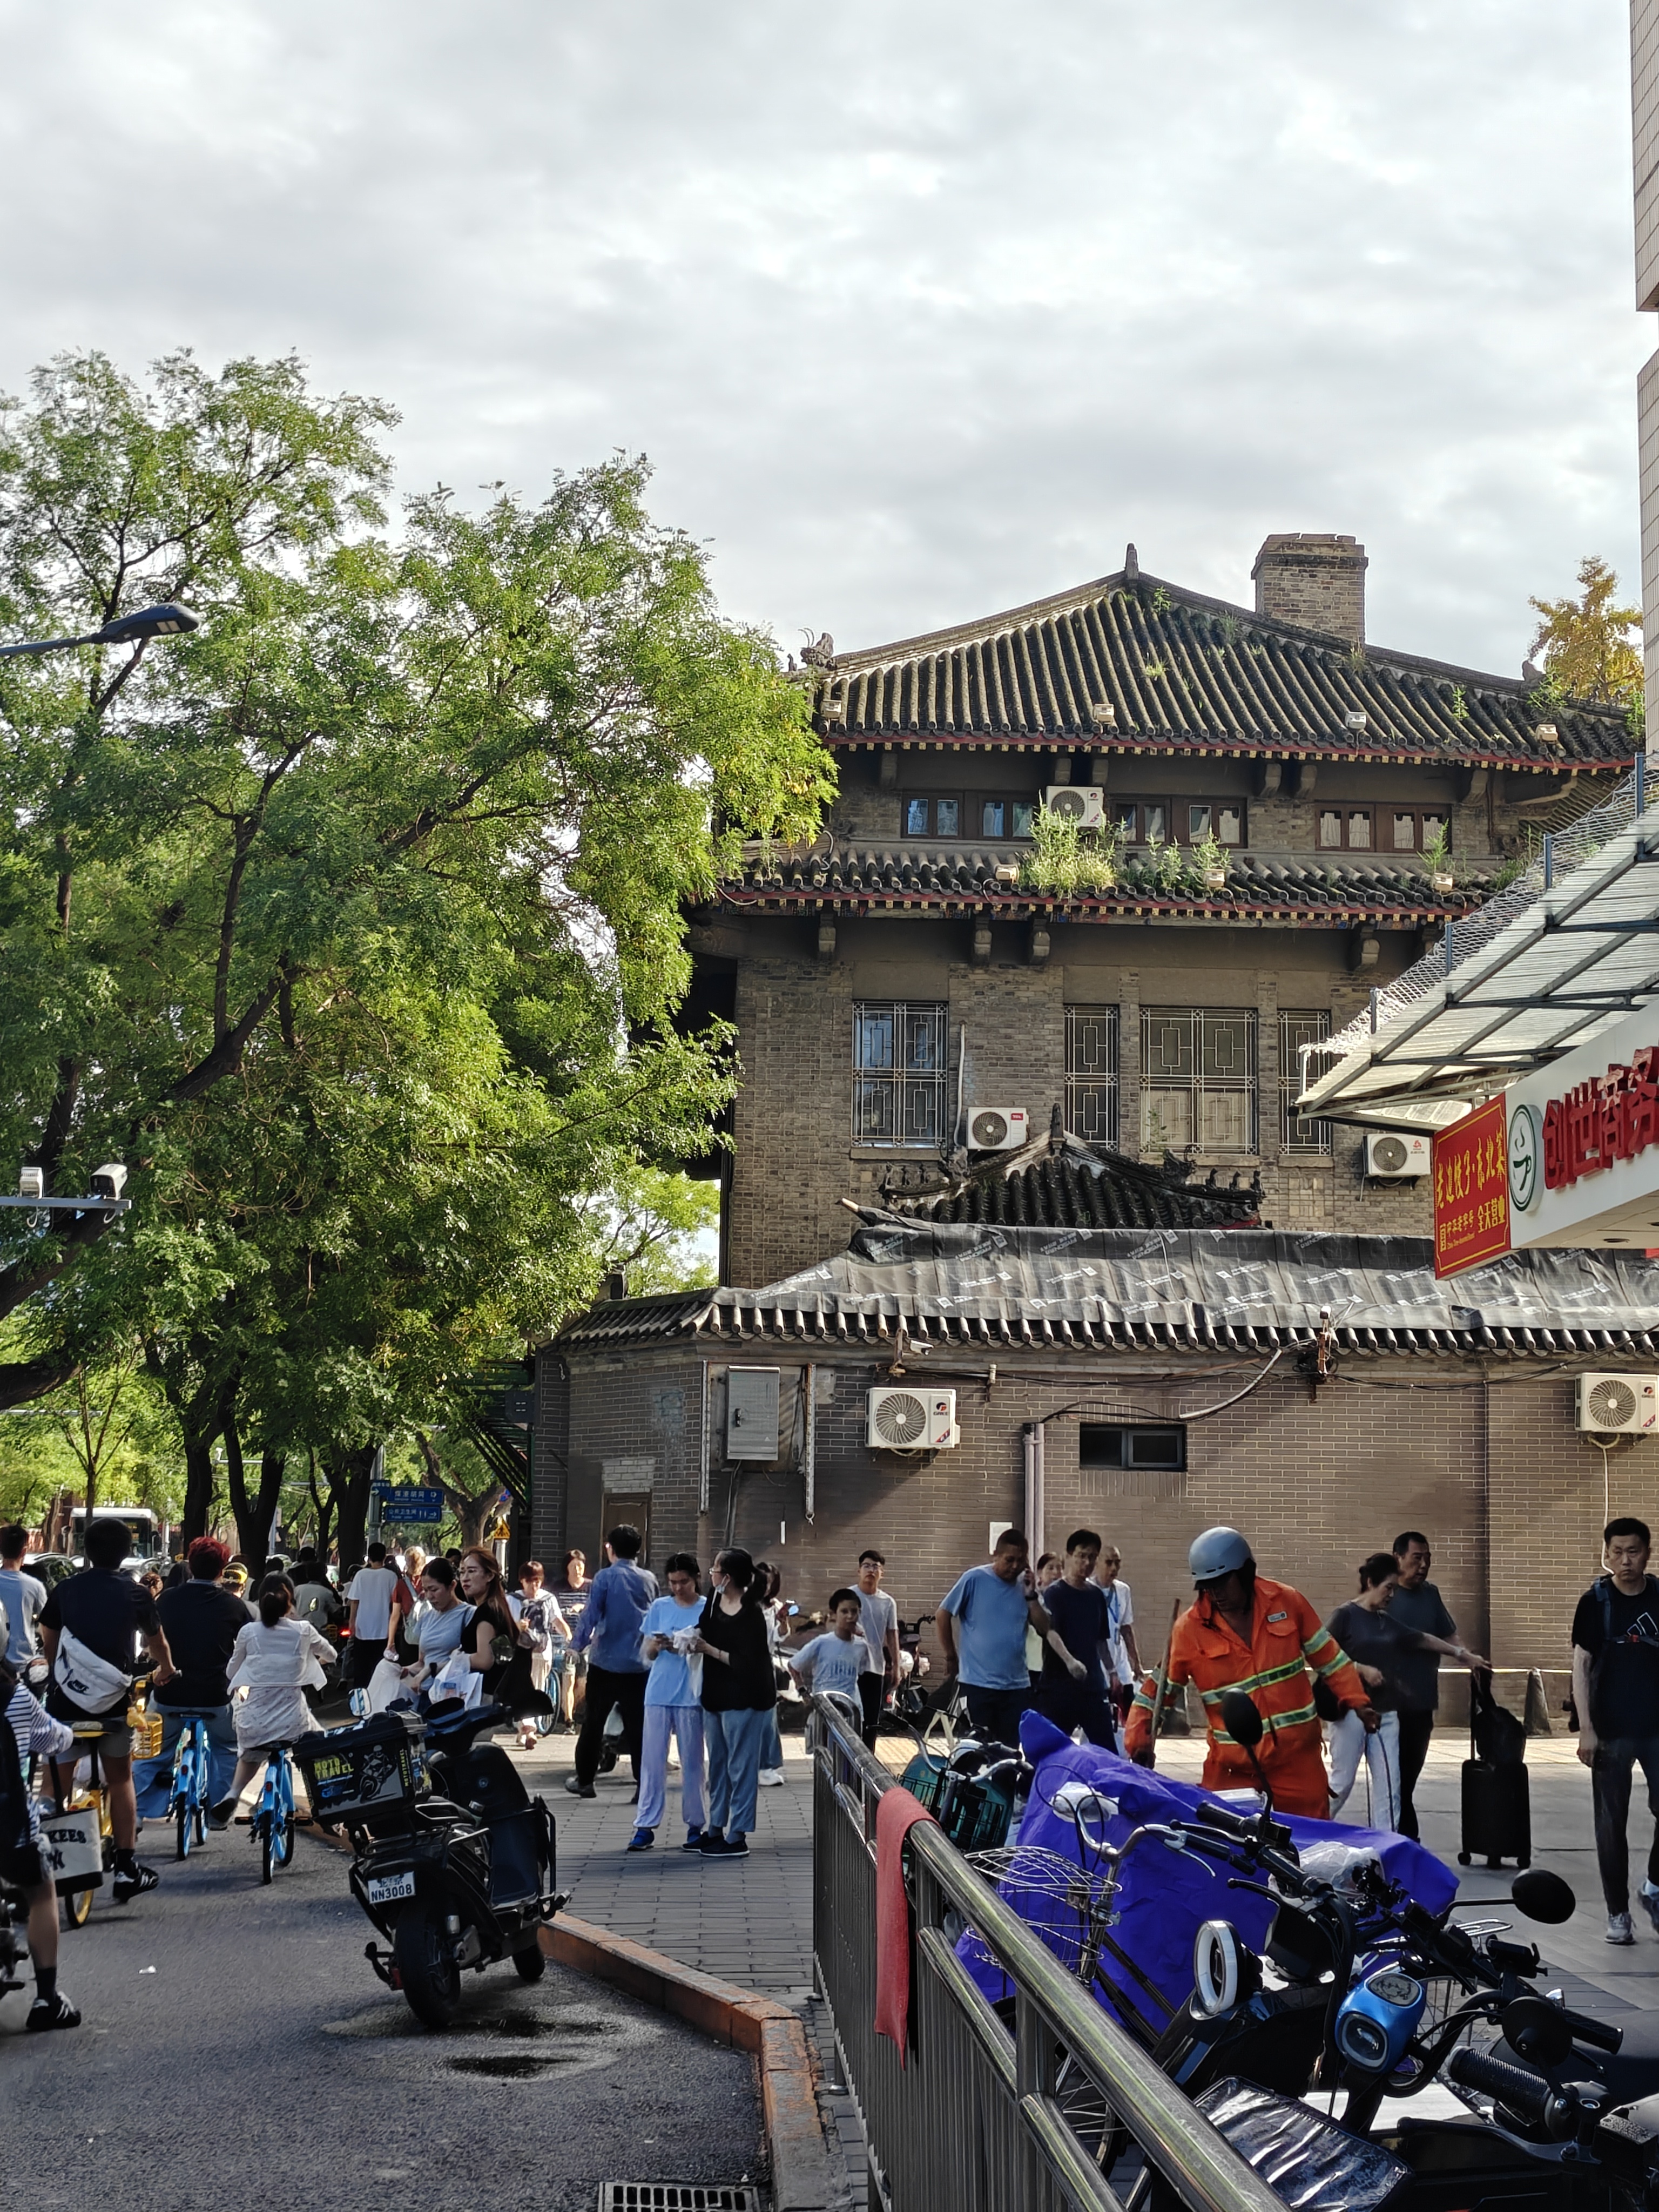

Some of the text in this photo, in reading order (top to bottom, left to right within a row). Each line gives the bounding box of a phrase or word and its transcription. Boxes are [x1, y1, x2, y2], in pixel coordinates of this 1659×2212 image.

[1478, 1195, 1506, 1233] 全天营业
[314, 1757, 340, 1771] MOTO
[315, 1763, 354, 1779] TRAVEL
[371, 1883, 413, 1901] NN3008
